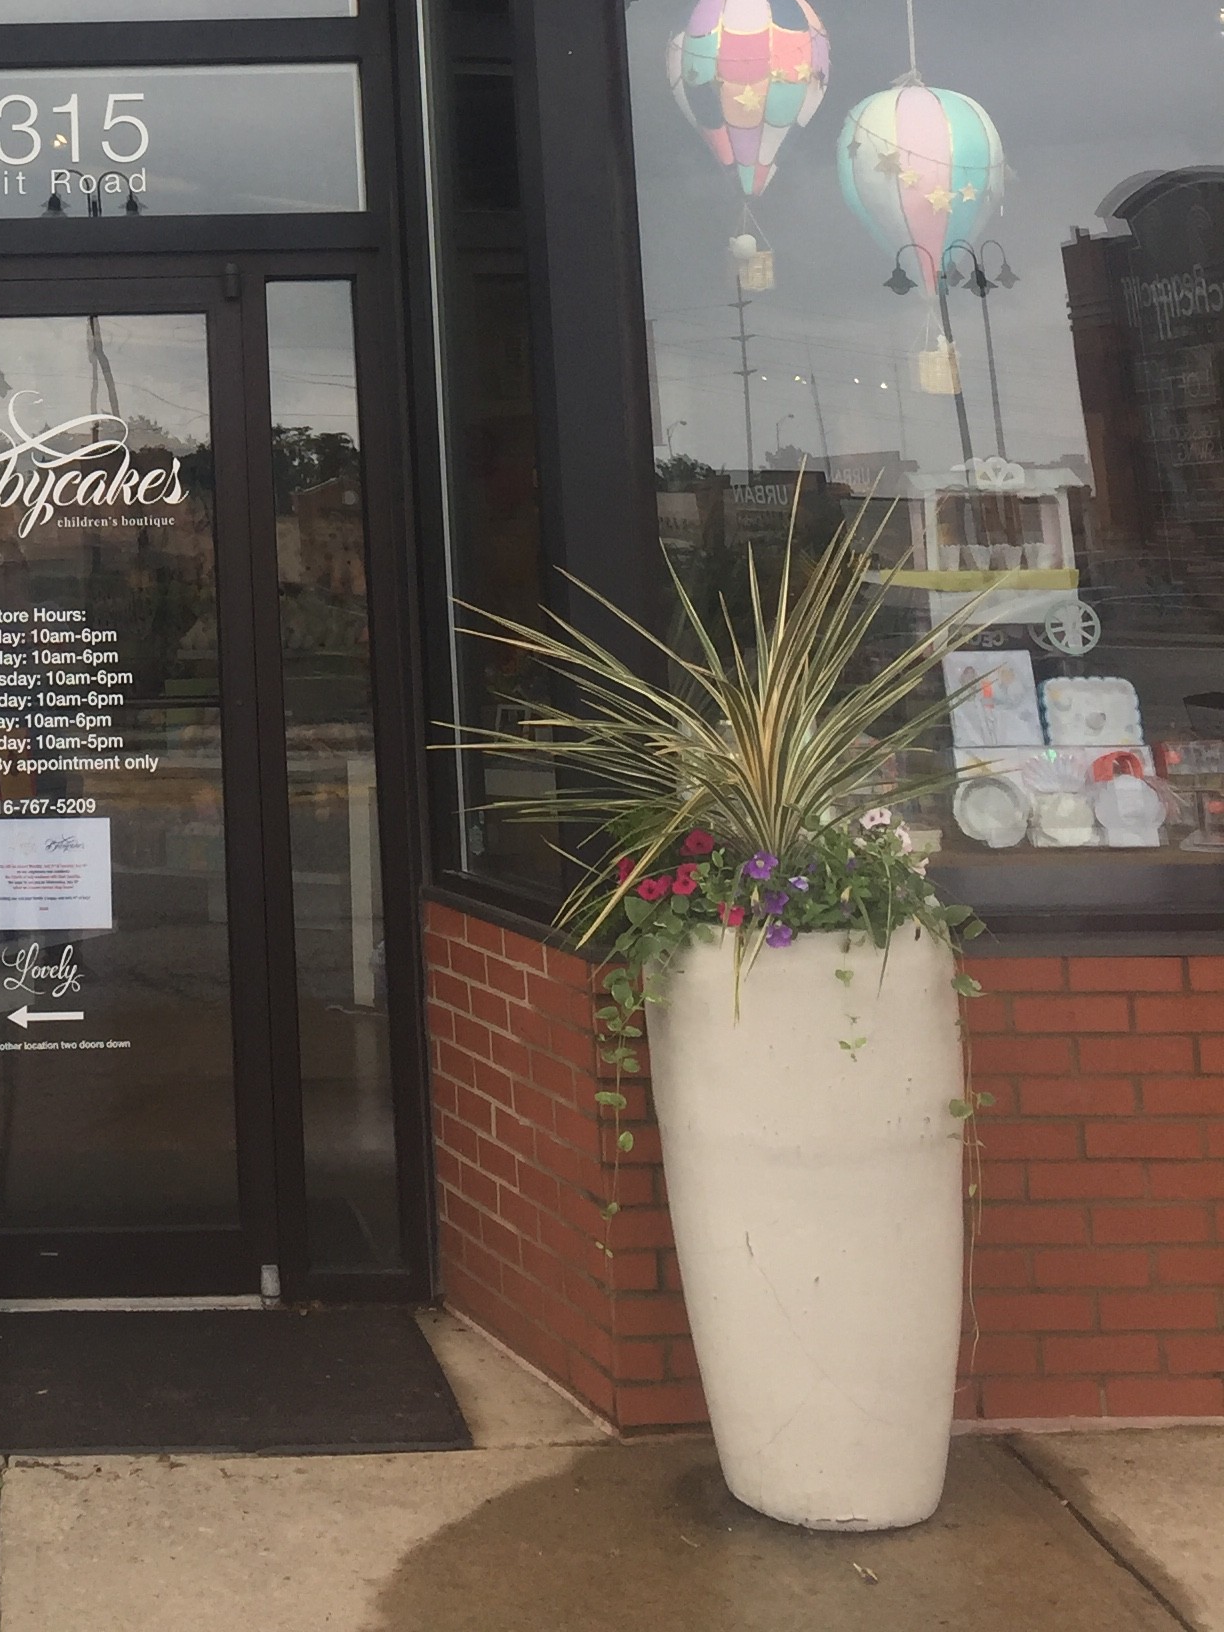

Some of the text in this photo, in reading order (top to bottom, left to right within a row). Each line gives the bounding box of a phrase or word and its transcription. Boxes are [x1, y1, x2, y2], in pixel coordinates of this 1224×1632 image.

[50, 167, 147, 195] Road
[121, 514, 176, 528] boutique
[33, 607, 86, 622] Hours:
[30, 628, 117, 646] 10am-6pm
[31, 648, 119, 667] 10am-6pm
[45, 669, 133, 688] 10am-6pm
[36, 690, 124, 709] 10am-6pm
[24, 712, 112, 731] 10am-6pm
[35, 733, 124, 752] 10am-5pm
[16, 754, 121, 775] appointment
[124, 754, 159, 773] only
[1, 942, 85, 998] Lovely
[24, 1040, 59, 1050] location
[60, 1041, 77, 1050] two
[78, 1040, 105, 1050] doors
[106, 1039, 131, 1049] down
